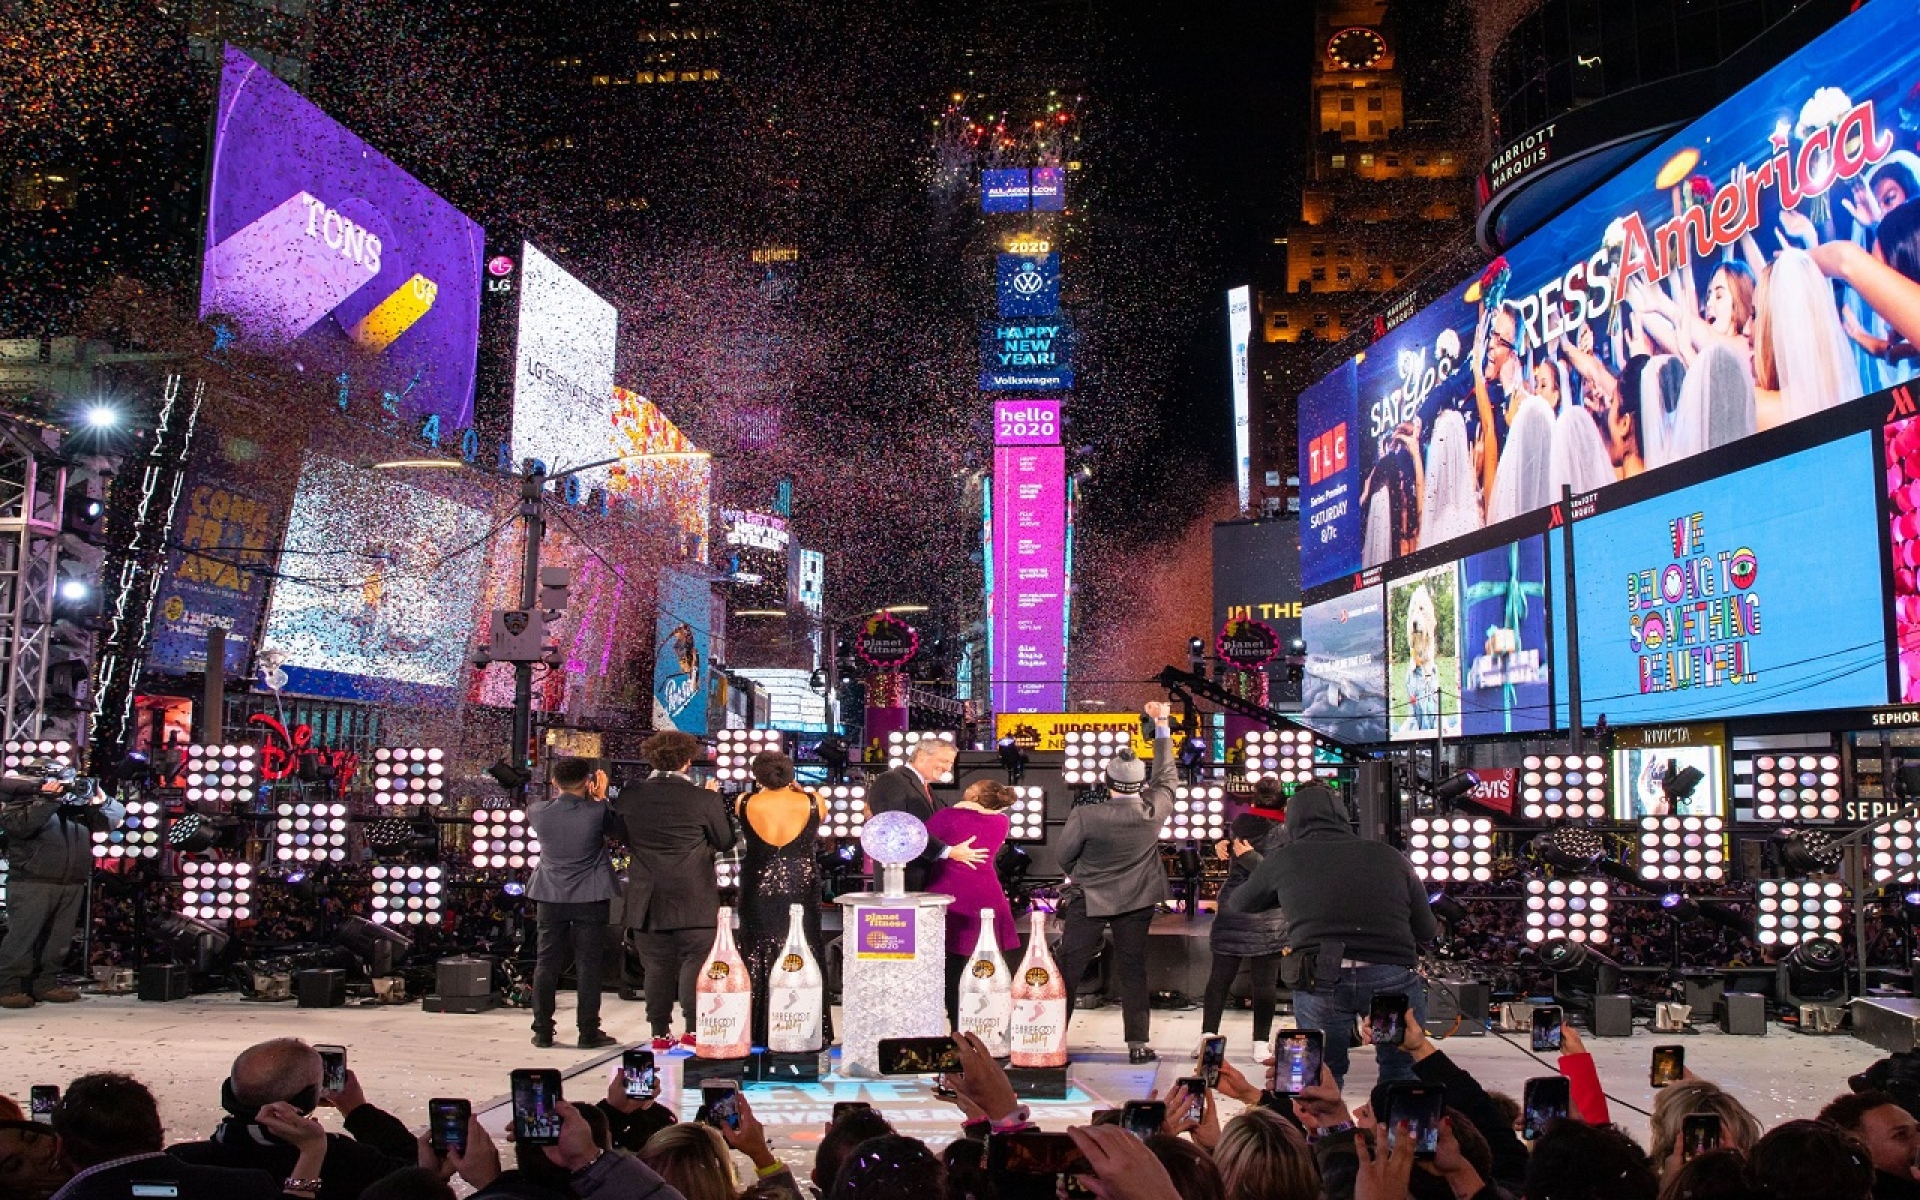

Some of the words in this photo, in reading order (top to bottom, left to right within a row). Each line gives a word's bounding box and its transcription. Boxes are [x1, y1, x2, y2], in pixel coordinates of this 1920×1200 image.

[1491, 124, 1556, 175] MARRIOTT
[1492, 146, 1548, 191] MARQUIS
[1612, 100, 1893, 302] America
[301, 194, 382, 275] TONS
[1009, 242, 1050, 253] 2020
[488, 280, 511, 292] LG
[996, 327, 1060, 339] HAPPY
[1005, 340, 1051, 352] NEW
[999, 353, 1056, 365] YEAR!
[994, 375, 1060, 385] Volkswagen
[1000, 408, 1054, 422] hello
[1371, 389, 1403, 437] SAY
[1000, 422, 1054, 436] 2020
[1310, 434, 1346, 475] TLC
[1570, 493, 1598, 507] ARRIOTT
[1310, 500, 1348, 529] SATURDAY
[1320, 524, 1338, 543] 8/7c
[1669, 511, 1704, 558] WE
[1628, 555, 1714, 612] BELONG
[1718, 546, 1758, 594] TO
[1227, 604, 1251, 620] IN
[1258, 602, 1302, 619] THE
[1629, 591, 1761, 652] SOMETHING
[863, 638, 902, 650] planet
[868, 645, 910, 654] fitness
[1223, 639, 1264, 651] planet
[1230, 646, 1273, 656] fitness
[1639, 640, 1758, 694] BEAUTIFUL
[1872, 711, 1920, 725] SEPHOR
[1049, 723, 1139, 736] JUDGEMEN
[1643, 727, 1691, 744] INVICTA
[1846, 801, 1918, 821] SEPH
[865, 913, 899, 921] planet
[869, 919, 907, 928] fitness
[698, 1017, 736, 1027] BAREFOOT
[772, 1012, 811, 1021] BAREFOOT
[961, 1017, 1000, 1027] BAREFOOT
[1015, 1025, 1056, 1035] BAREFOOT
